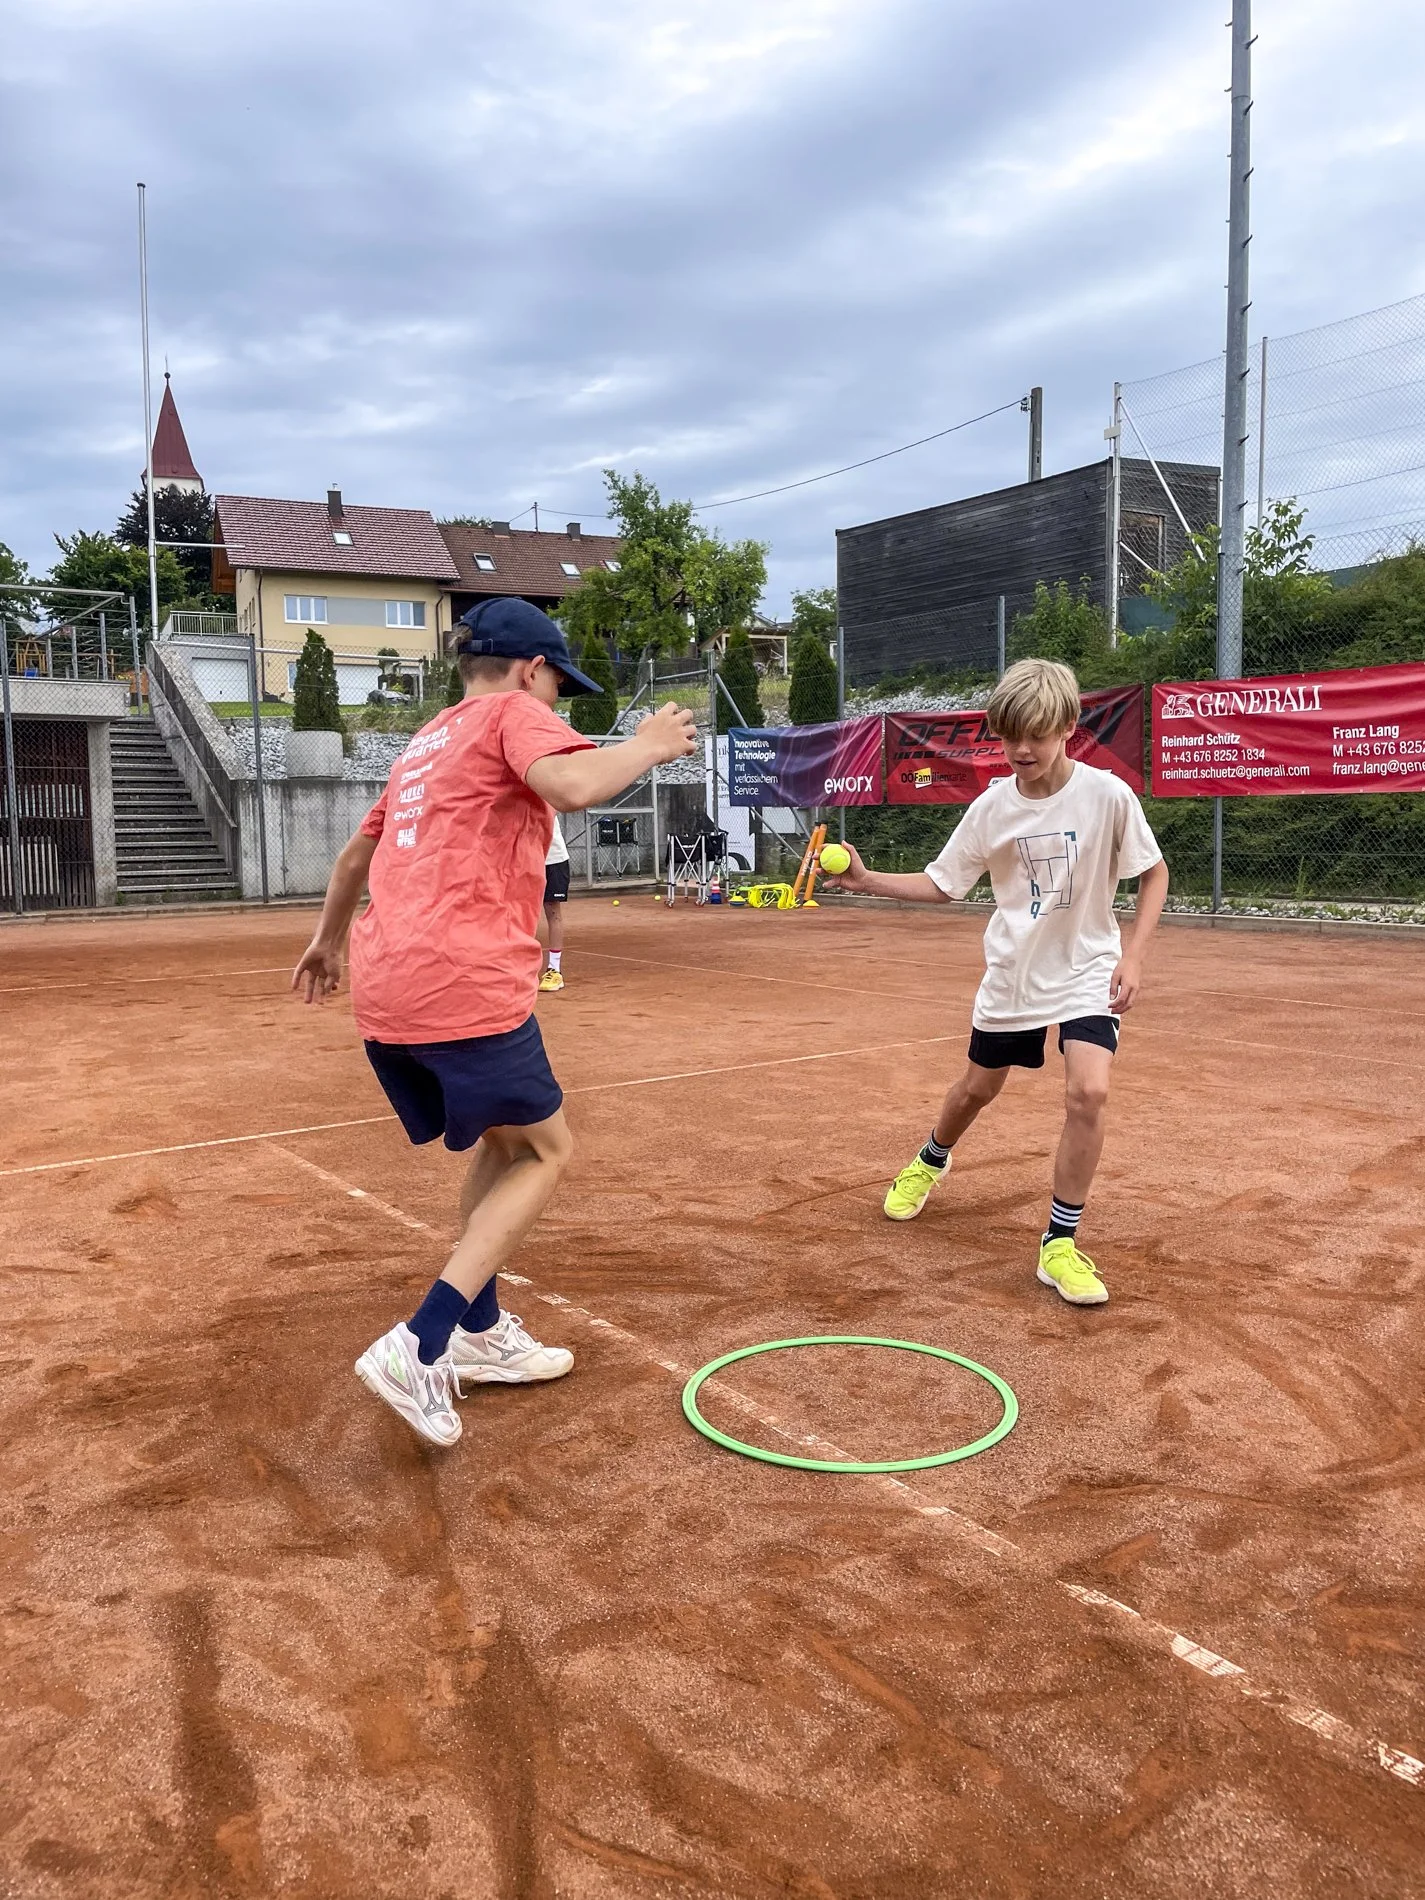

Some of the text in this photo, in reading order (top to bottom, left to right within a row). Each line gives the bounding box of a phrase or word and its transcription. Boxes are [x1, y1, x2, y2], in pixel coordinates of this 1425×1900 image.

[1196, 685, 1323, 717] GENERALI
[1332, 724, 1400, 739] Franz Lang
[1161, 733, 1240, 748] Reinhard Schütz
[934, 747, 1004, 759] SUPPL
[1162, 748, 1265, 764] M +43 676 8252 1834
[1332, 744, 1343, 757] M
[1347, 743, 1371, 757] +43
[1373, 741, 1396, 756] 676
[1162, 764, 1310, 780] reinhard.schuetz@generali.com
[824, 775, 873, 794] eworx
[393, 805, 424, 821] eworx
